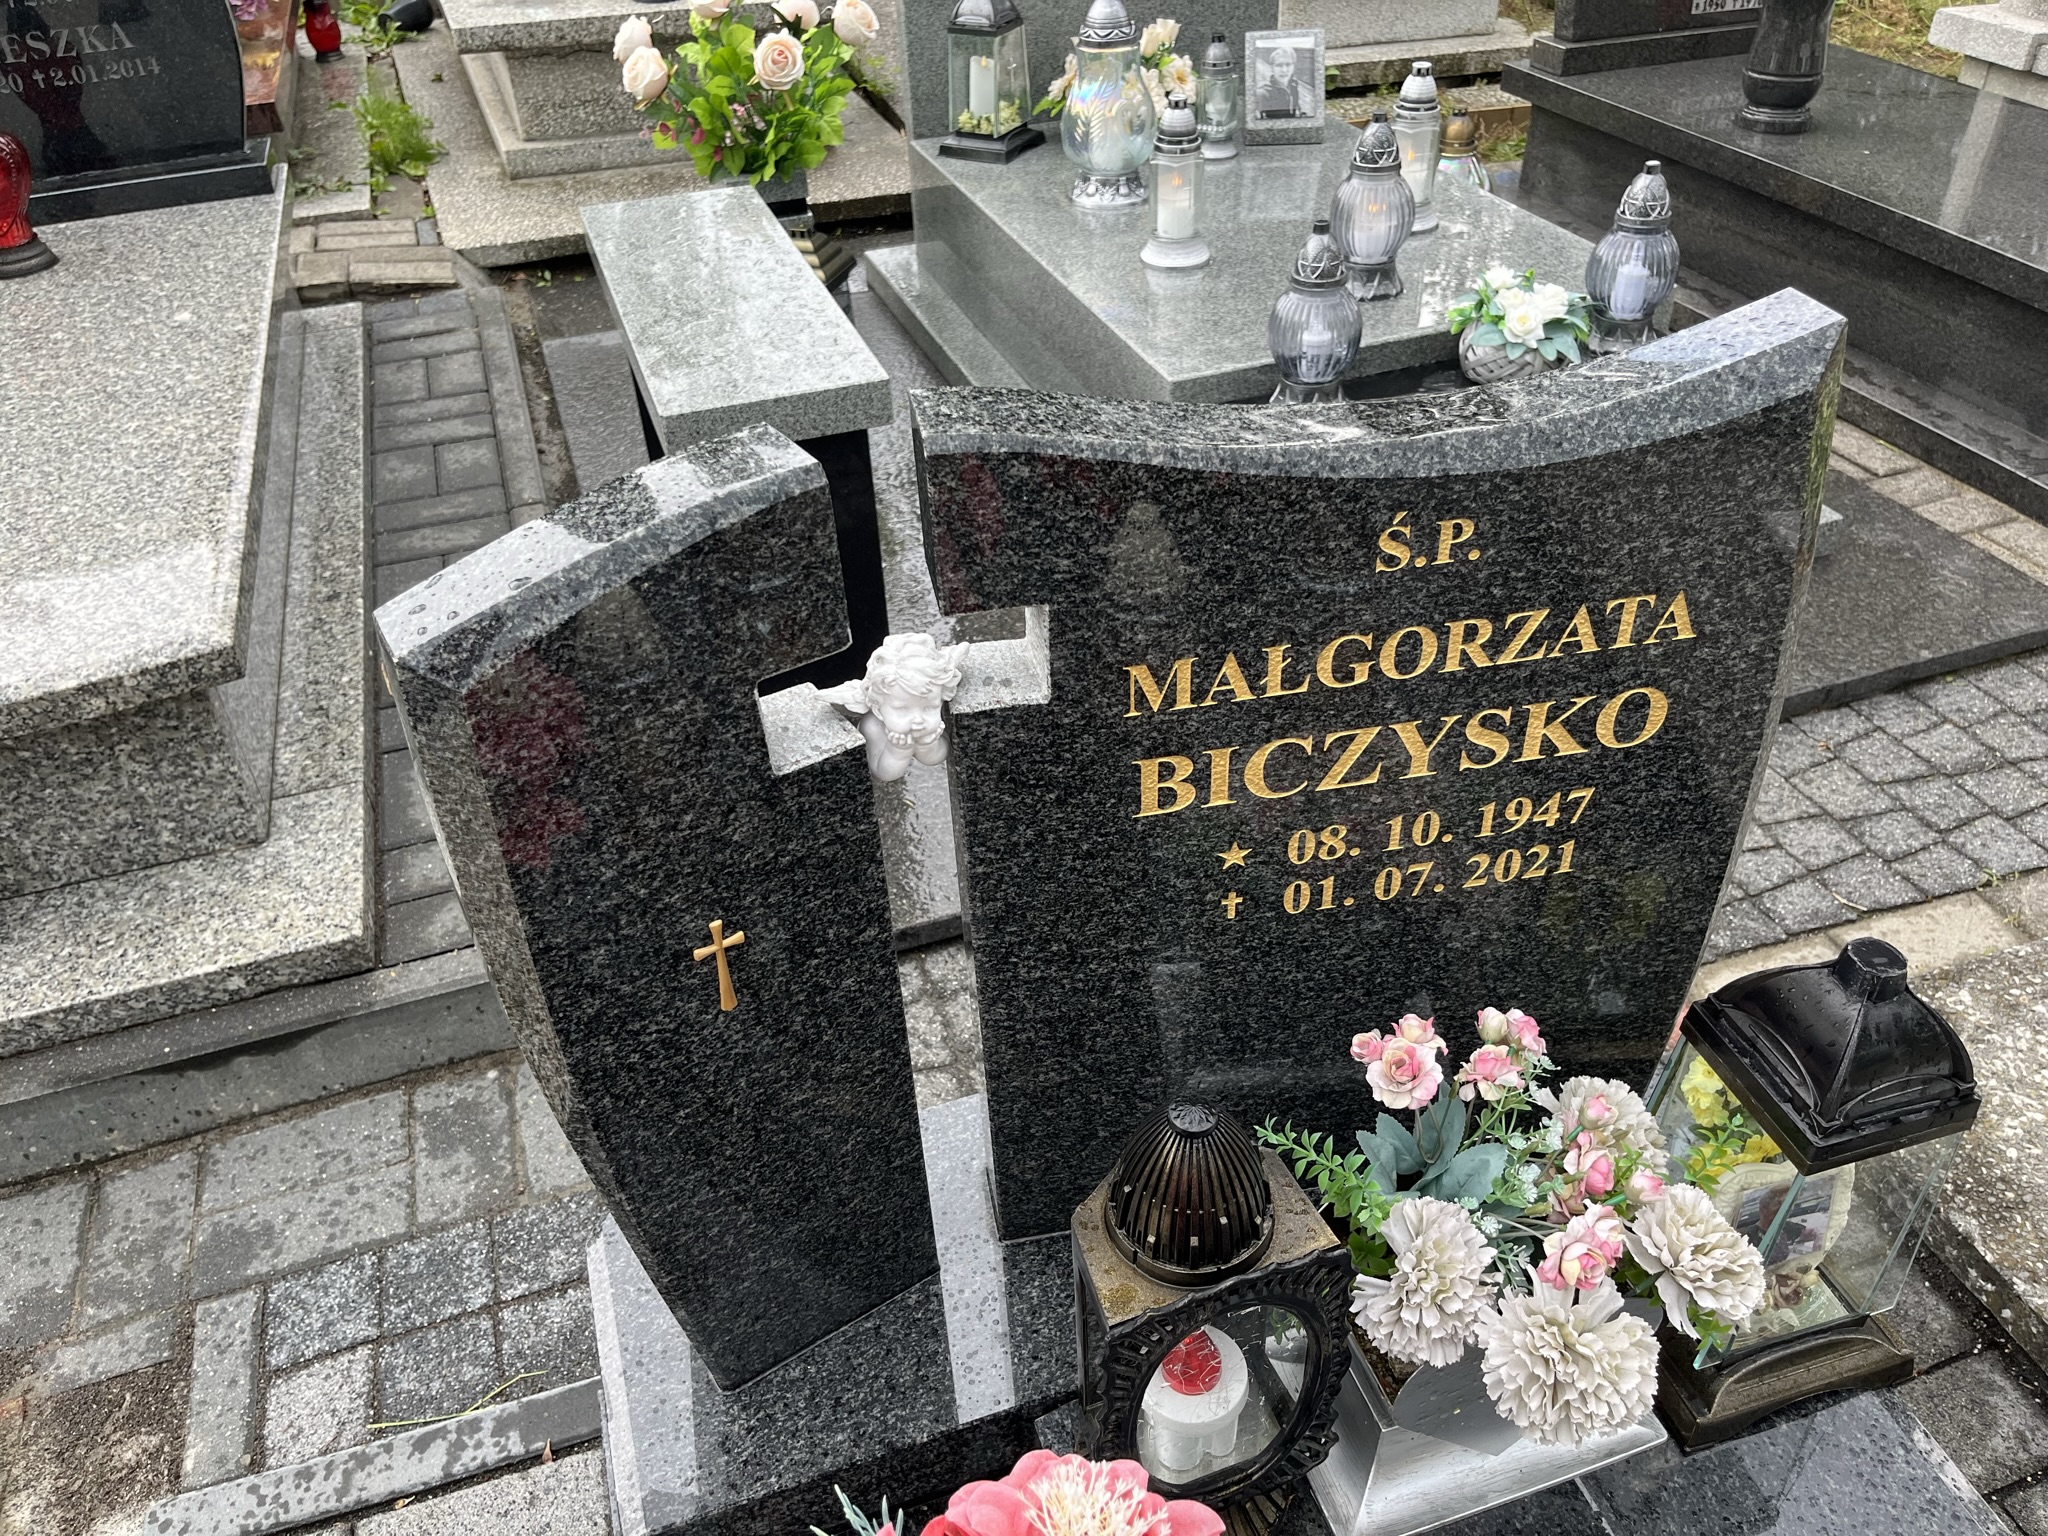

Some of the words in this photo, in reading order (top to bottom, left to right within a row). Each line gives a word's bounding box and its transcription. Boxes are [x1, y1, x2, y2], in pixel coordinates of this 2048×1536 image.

[0, 20, 136, 63] ESZKA
[1376, 511, 1481, 573] Ś.P.
[1123, 590, 1697, 718] MAŁGORZATA
[1132, 686, 1669, 818] BICZYSKO
[1287, 824, 1362, 865] 08.
[1383, 810, 1454, 852] 10.
[1475, 787, 1596, 838] 1947
[1282, 875, 1356, 914] 01.
[1373, 861, 1445, 902] 07.
[1463, 840, 1576, 889] 2021
